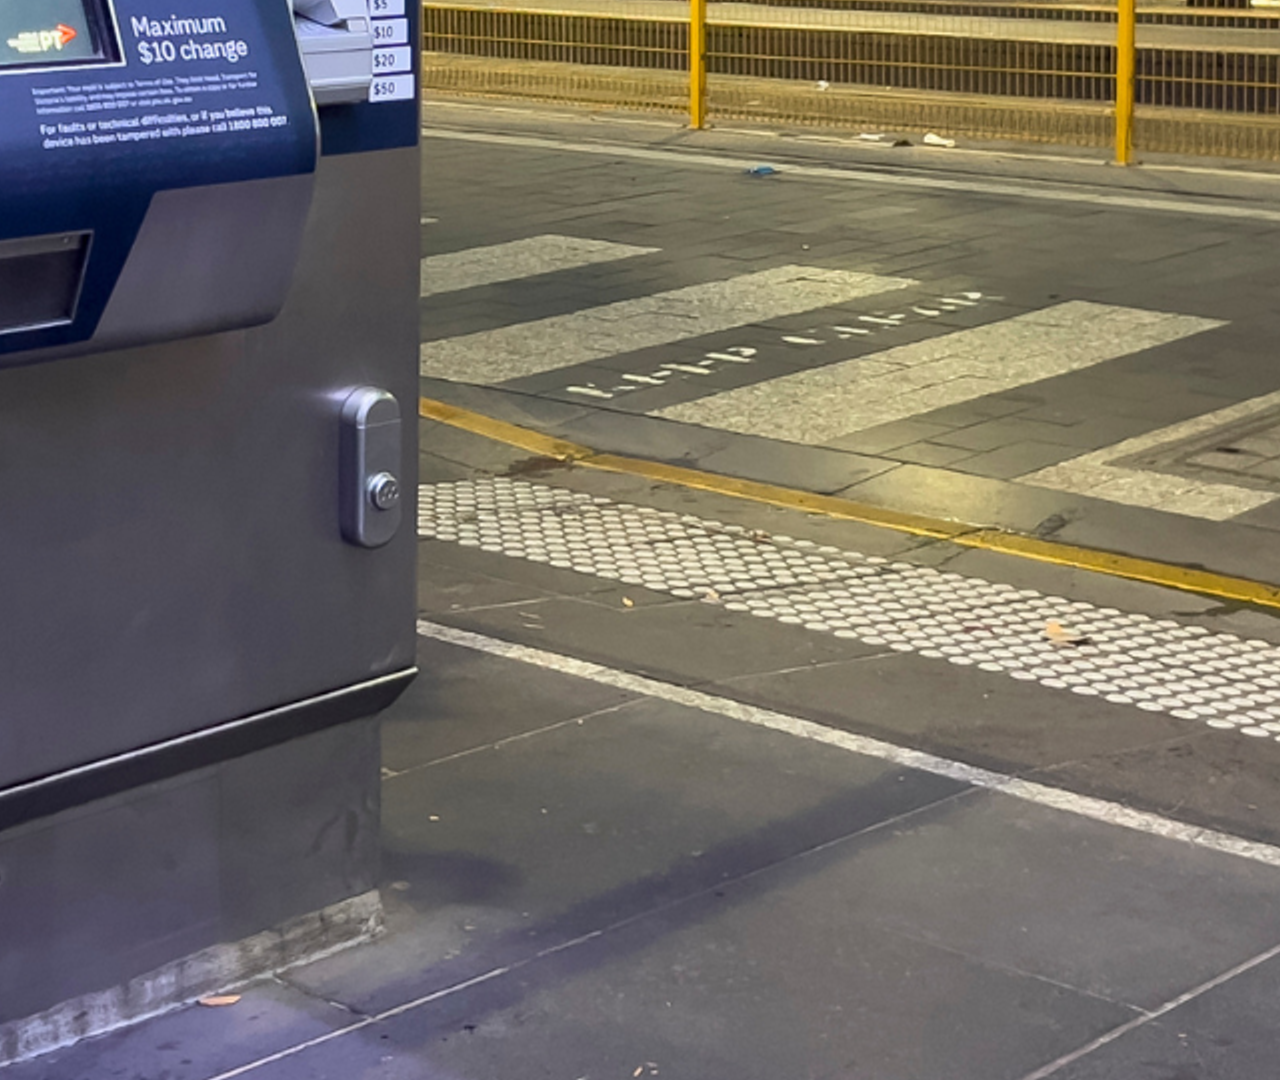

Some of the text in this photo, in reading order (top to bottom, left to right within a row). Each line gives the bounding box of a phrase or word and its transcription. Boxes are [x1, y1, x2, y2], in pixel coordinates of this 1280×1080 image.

[130, 15, 226, 38] Maximum
[373, 25, 393, 39] $10
[137, 38, 248, 65] $10 change
[373, 53, 396, 67] $20
[373, 82, 396, 96] $50
